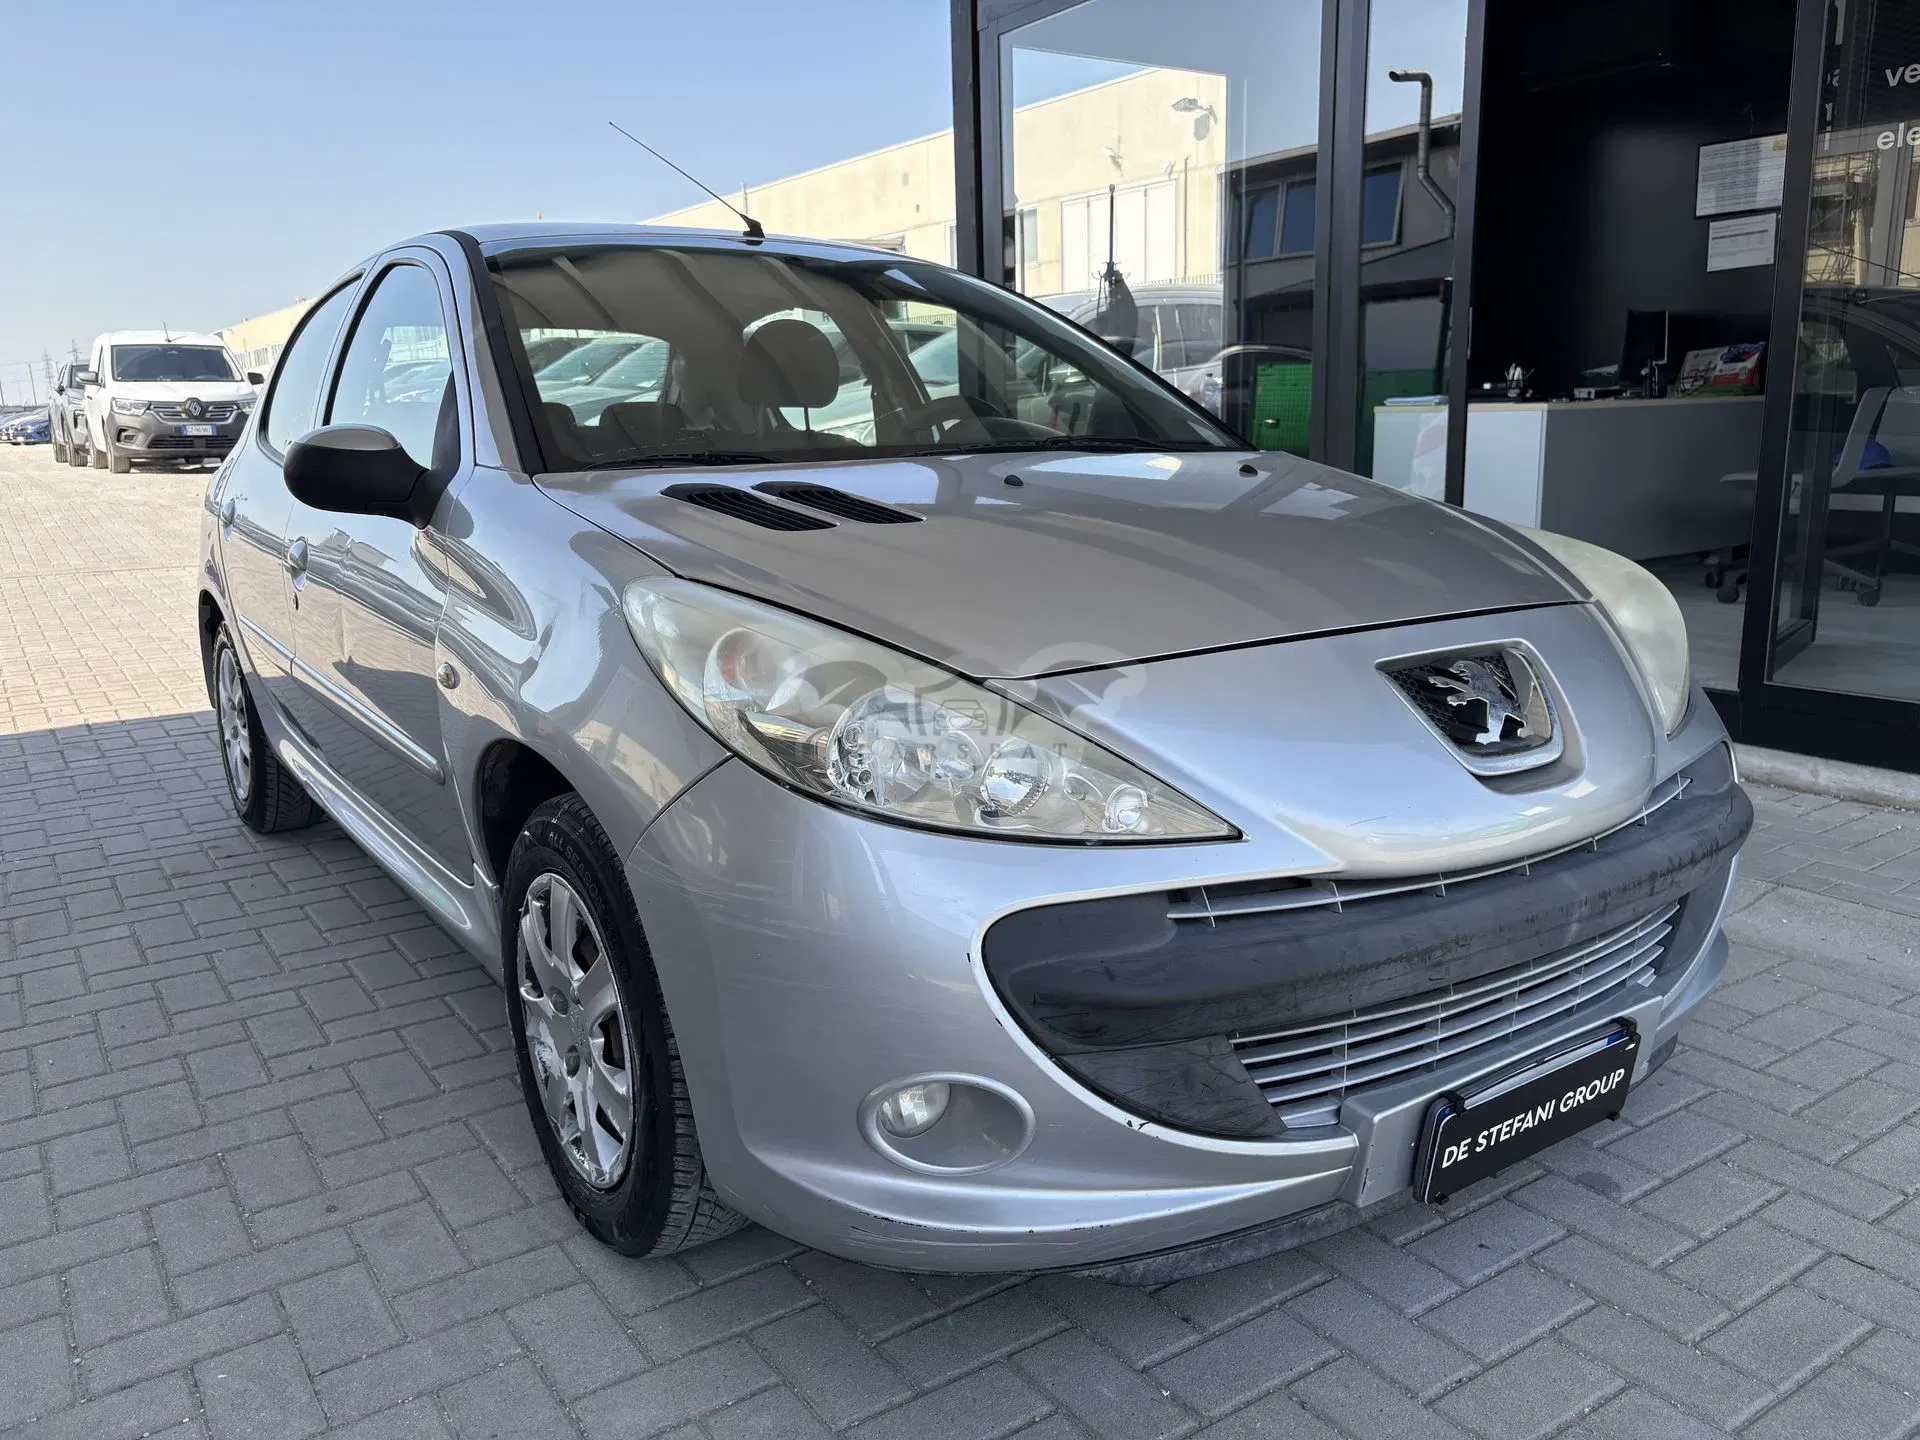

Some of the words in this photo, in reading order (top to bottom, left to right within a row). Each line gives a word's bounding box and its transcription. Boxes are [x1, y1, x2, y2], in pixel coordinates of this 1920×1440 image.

[1441, 1138, 1472, 1169] DE
[1475, 1099, 1556, 1153] STEFANI
[1559, 1068, 1625, 1113] GROUP
